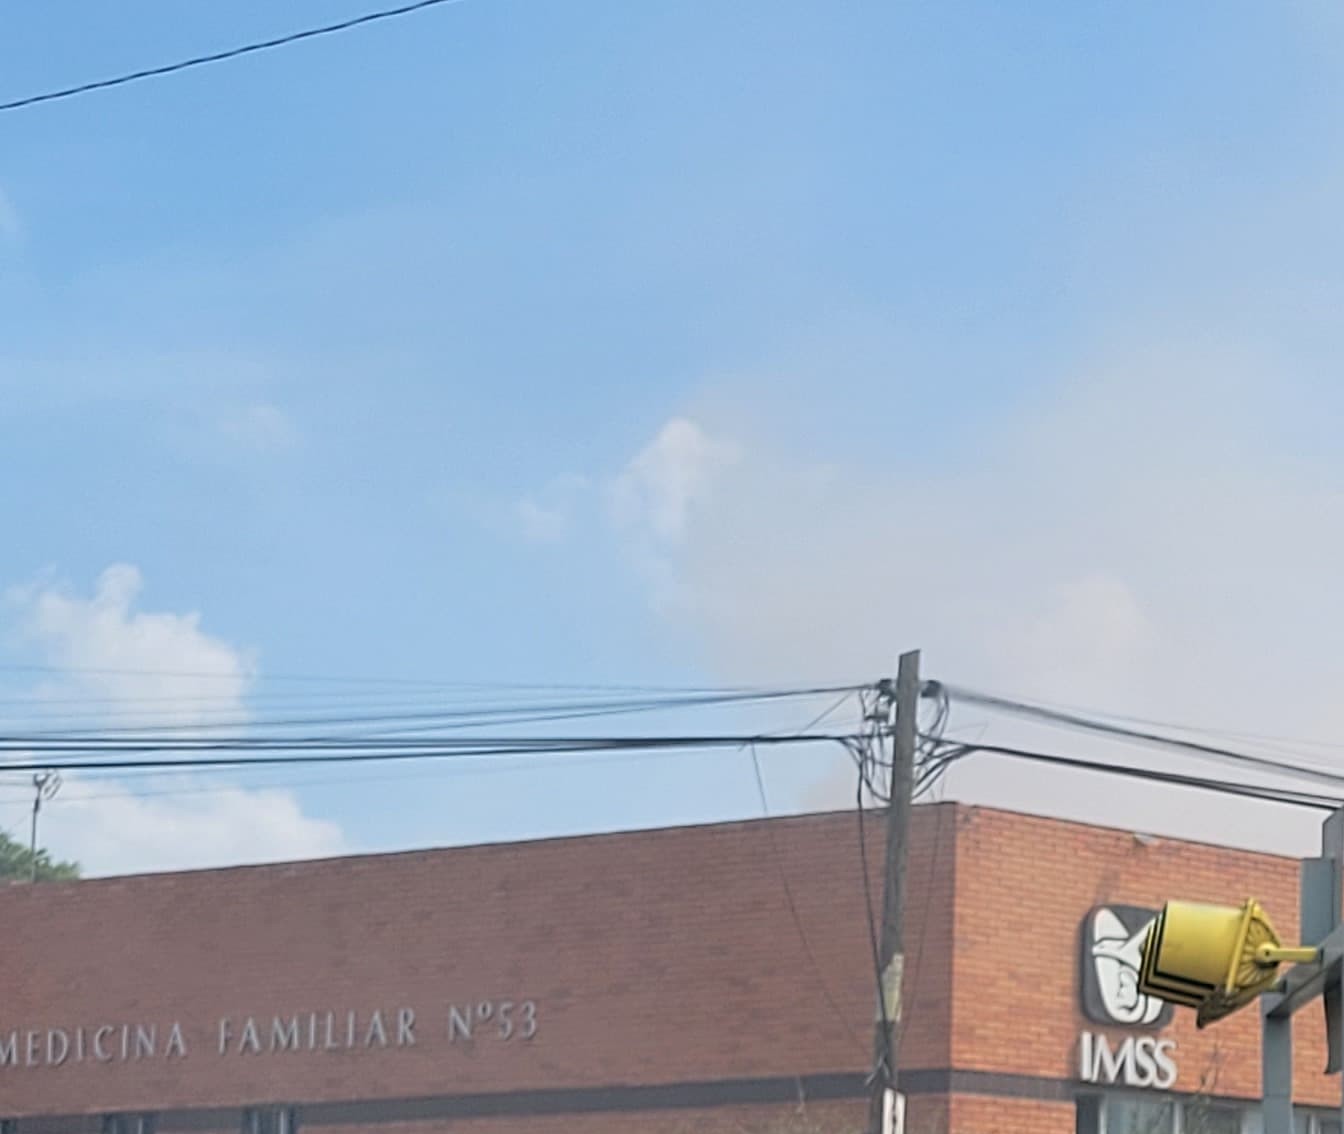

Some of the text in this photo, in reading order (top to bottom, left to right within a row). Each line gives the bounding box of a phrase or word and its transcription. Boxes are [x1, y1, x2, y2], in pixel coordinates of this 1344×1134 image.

[0, 1021, 187, 1066] MEDICINA
[218, 1007, 417, 1054] FAMILIAR
[1081, 1031, 1178, 1090] IMSS
